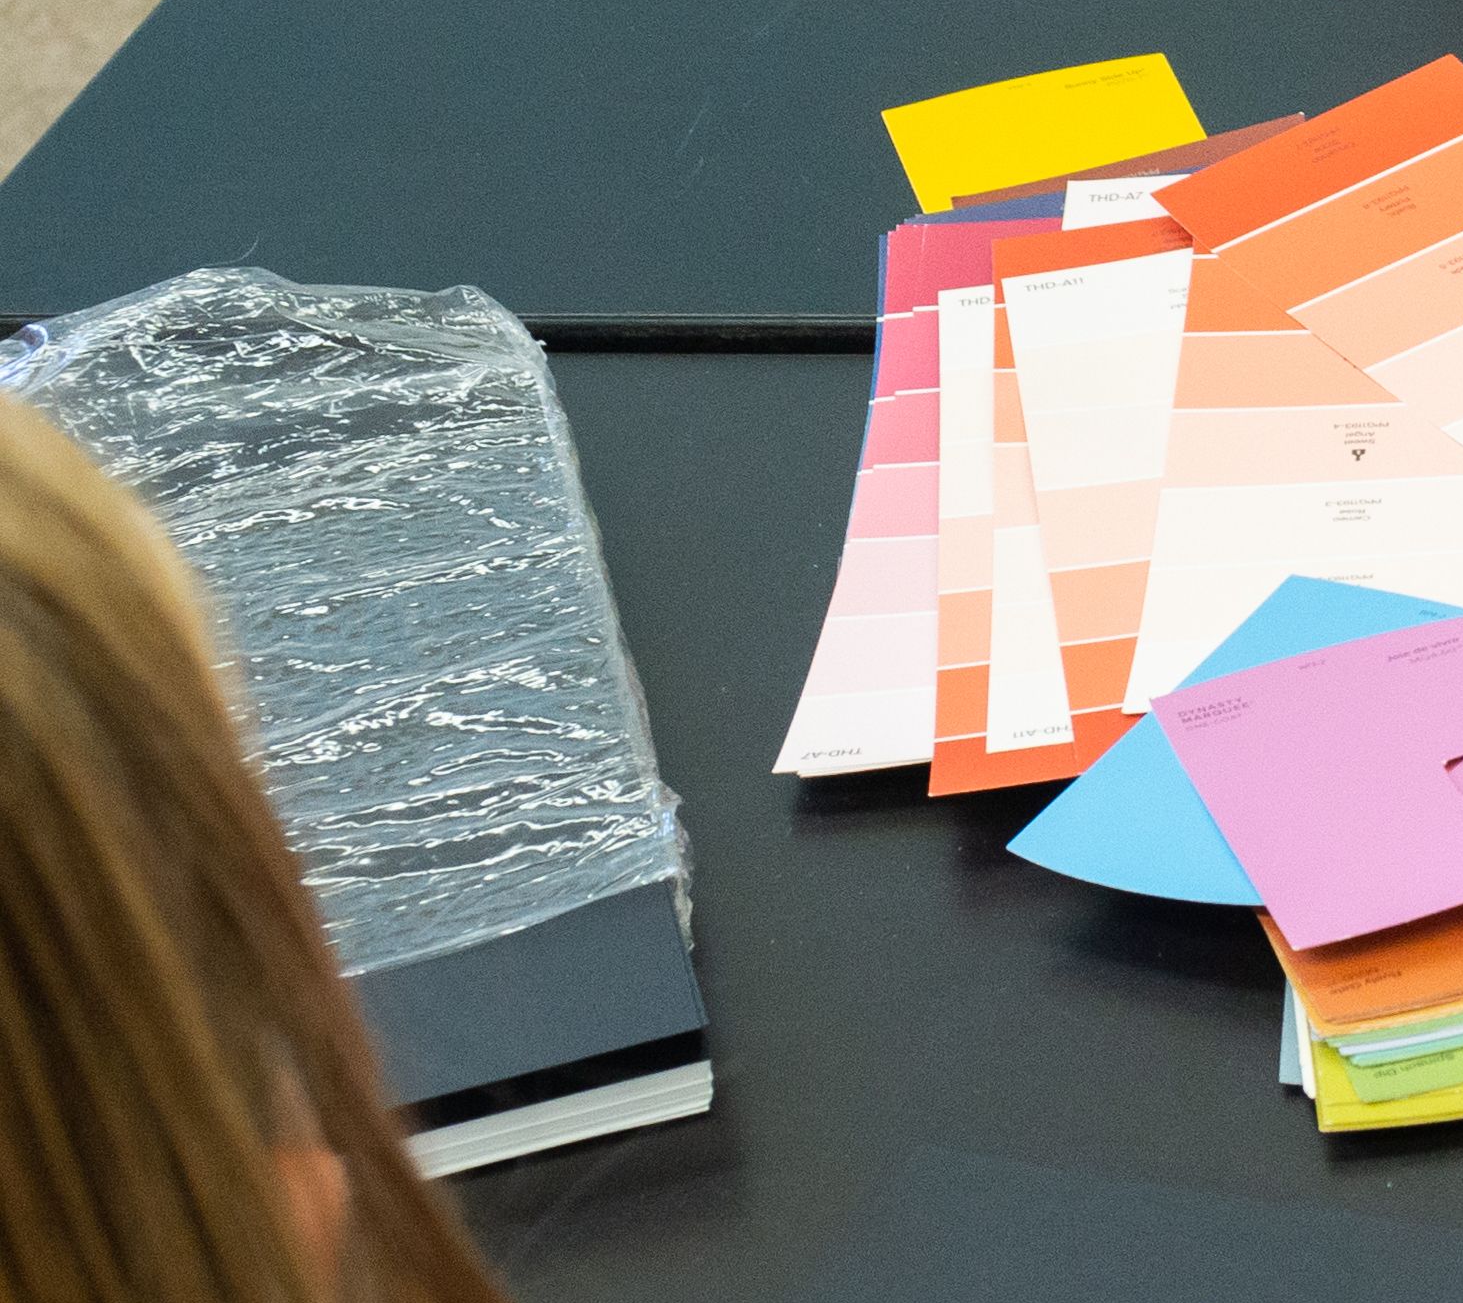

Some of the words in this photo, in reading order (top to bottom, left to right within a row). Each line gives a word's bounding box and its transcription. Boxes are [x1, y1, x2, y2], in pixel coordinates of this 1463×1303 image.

[1088, 191, 1145, 203] THD-A7
[1025, 277, 1085, 294] THD-A11
[1012, 725, 1072, 739] HD-A11
[801, 747, 863, 761] THD-A7
